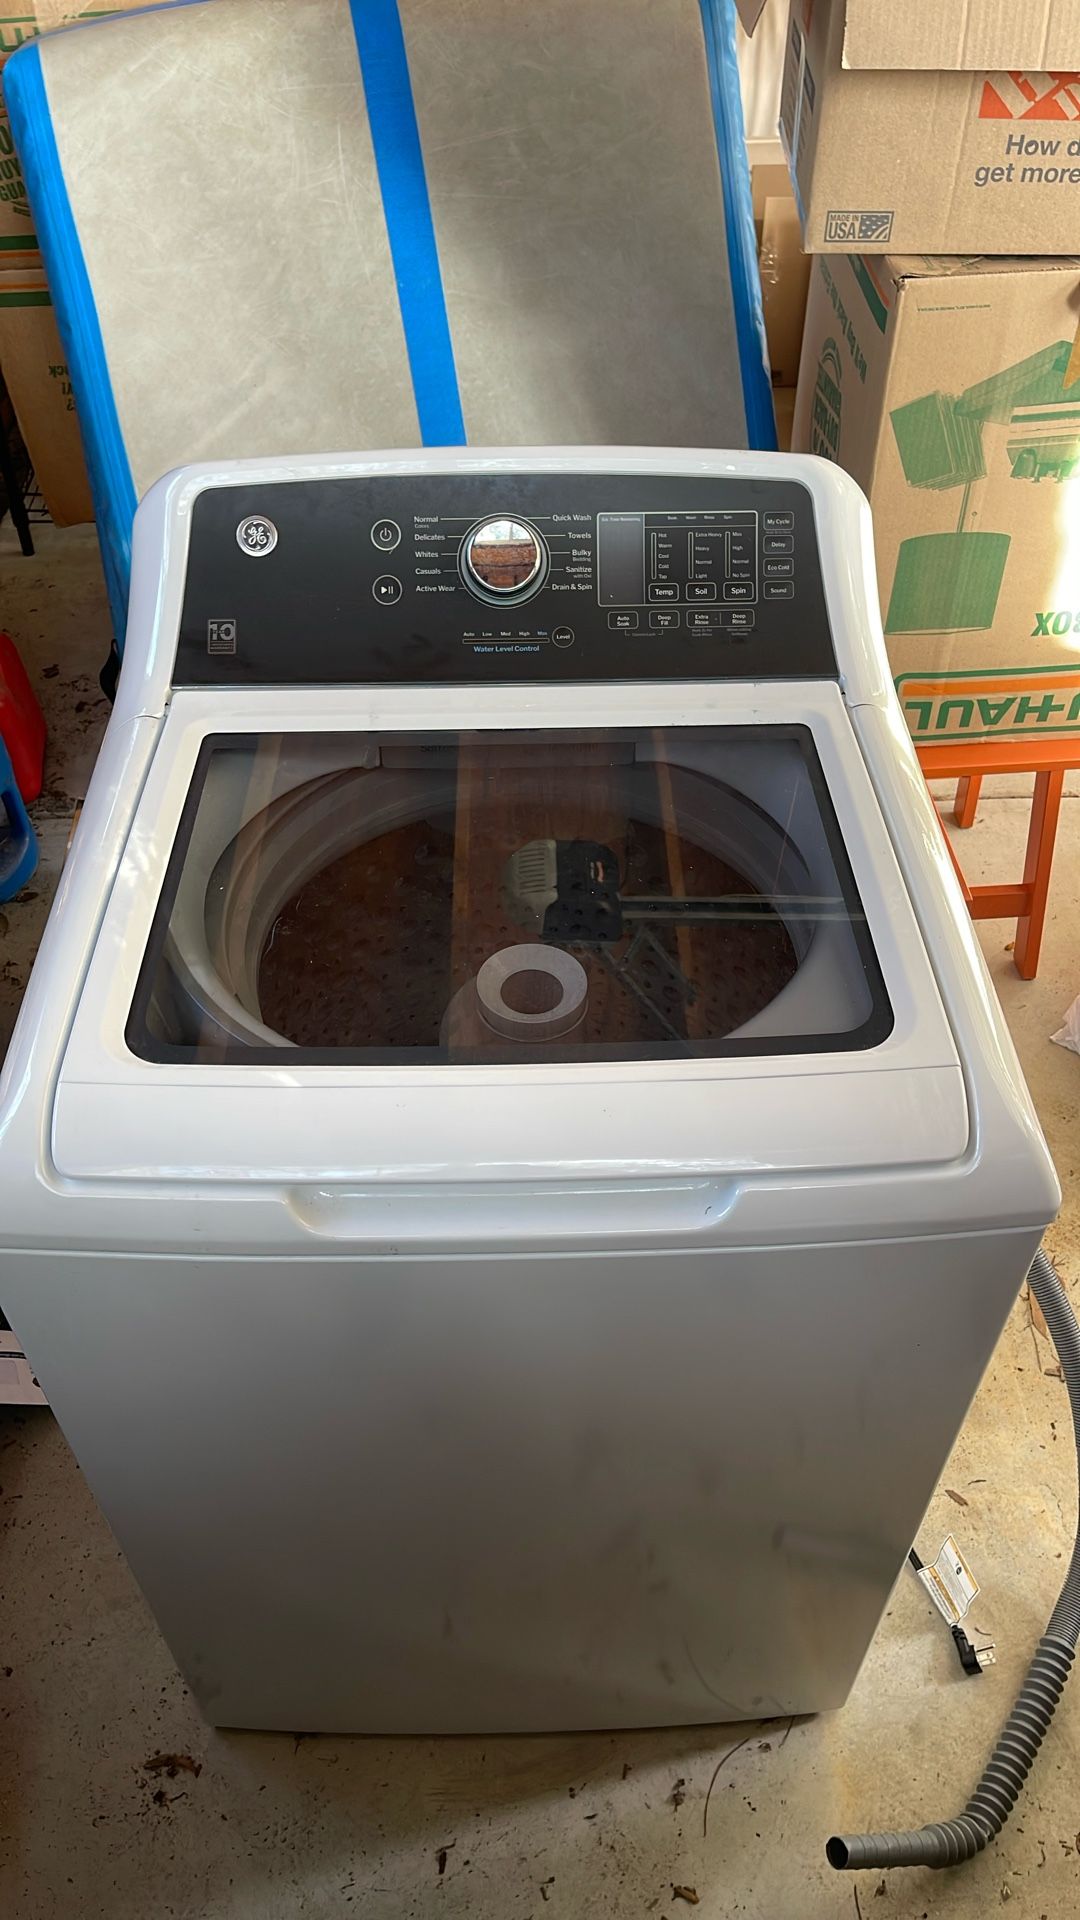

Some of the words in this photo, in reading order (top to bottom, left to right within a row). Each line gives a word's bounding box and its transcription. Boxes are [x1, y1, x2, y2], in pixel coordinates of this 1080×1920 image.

[1005, 134, 1061, 156] How
[974, 163, 1015, 187] get
[1020, 166, 1080, 183] more
[830, 214, 851, 222] MADE
[828, 222, 856, 239] USA
[552, 514, 572, 522] Quick
[414, 533, 446, 541] Delicates
[571, 549, 592, 557] Bulky
[551, 583, 570, 591] Drain
[577, 583, 593, 591] Spin
[731, 587, 747, 595] Spin
[655, 588, 674, 596] Temp
[209, 624, 234, 641] 10
[473, 645, 494, 653] Water
[495, 645, 514, 653] Level
